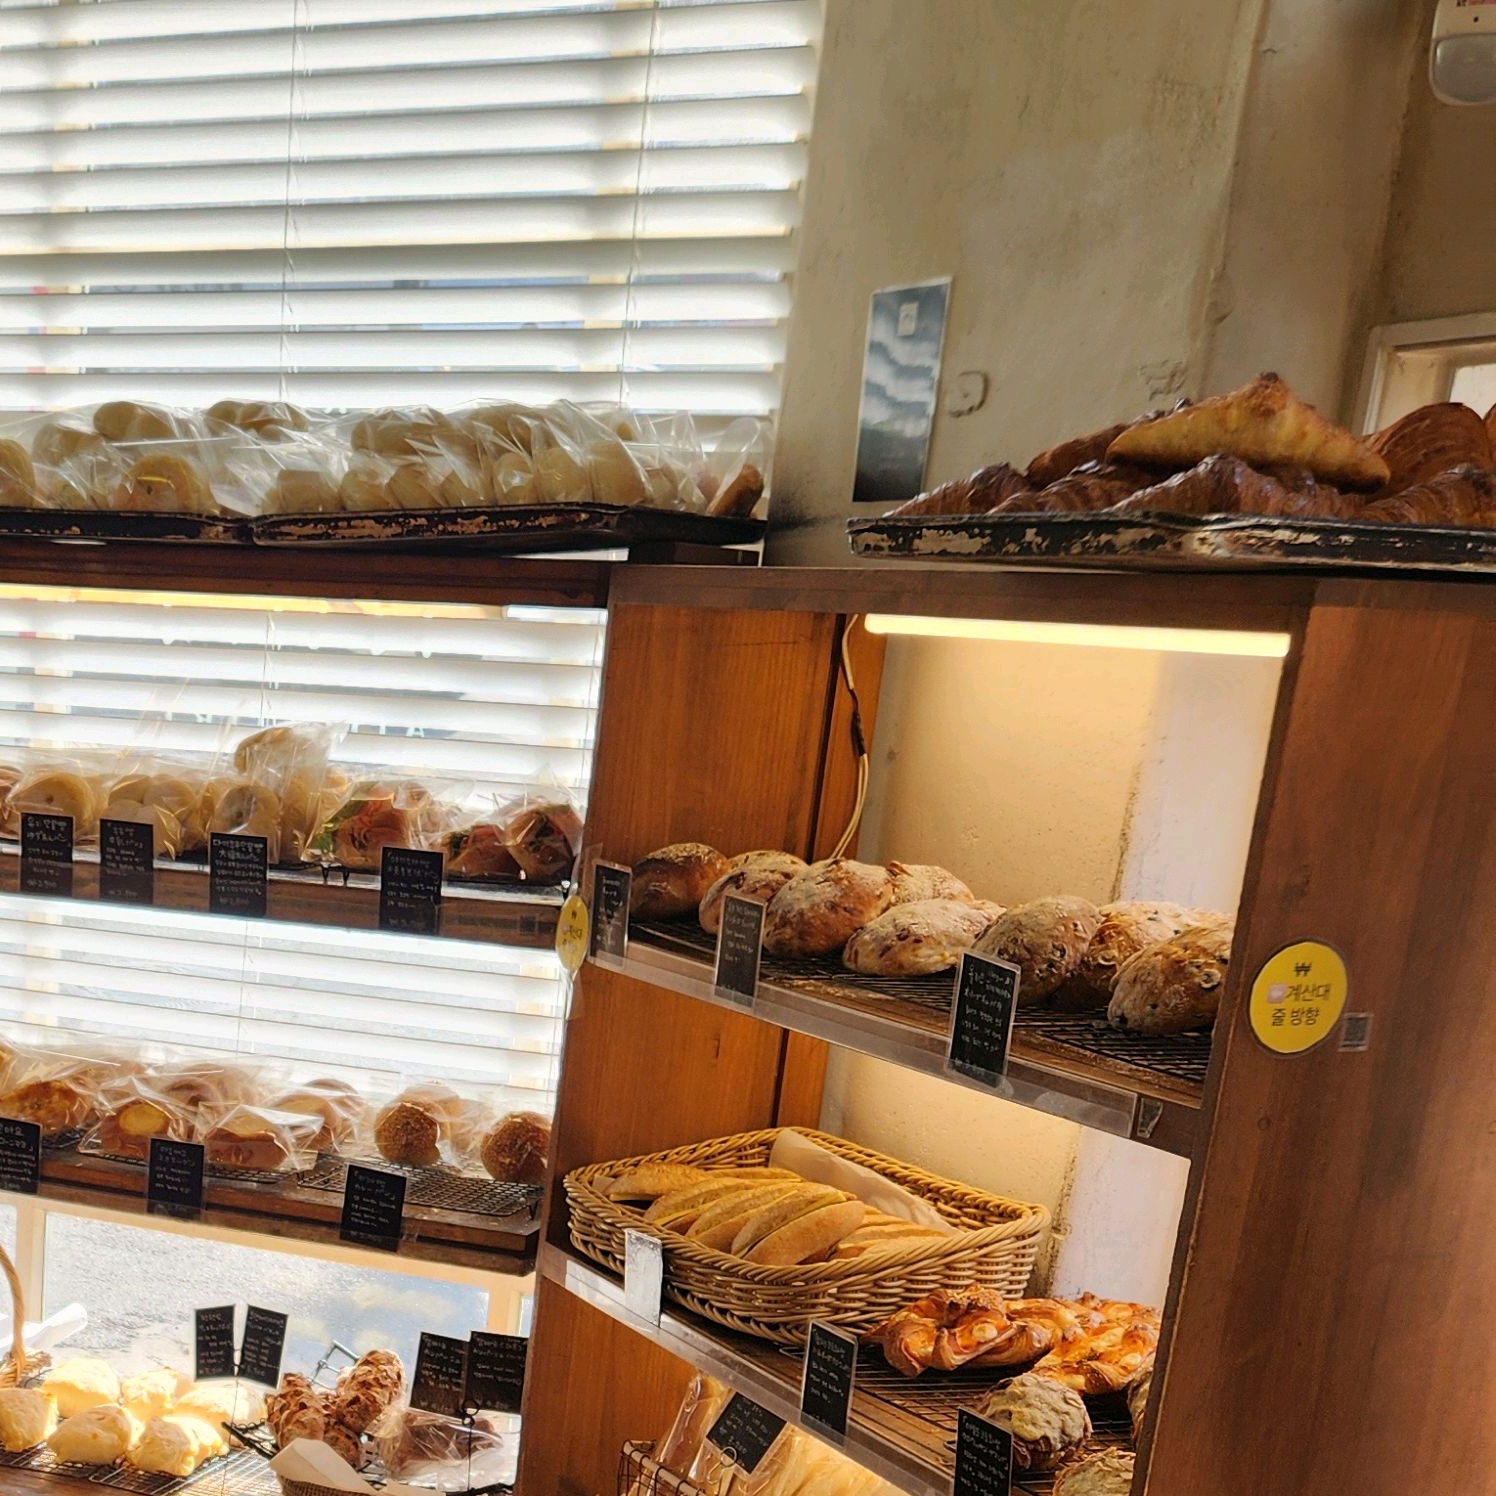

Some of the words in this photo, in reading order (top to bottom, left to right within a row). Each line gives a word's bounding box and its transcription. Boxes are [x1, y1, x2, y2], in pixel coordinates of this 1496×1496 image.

[1286, 984, 1331, 1001] 계산대
[1271, 1008, 1286, 1026] 줄
[1290, 1007, 1320, 1026] 방향
